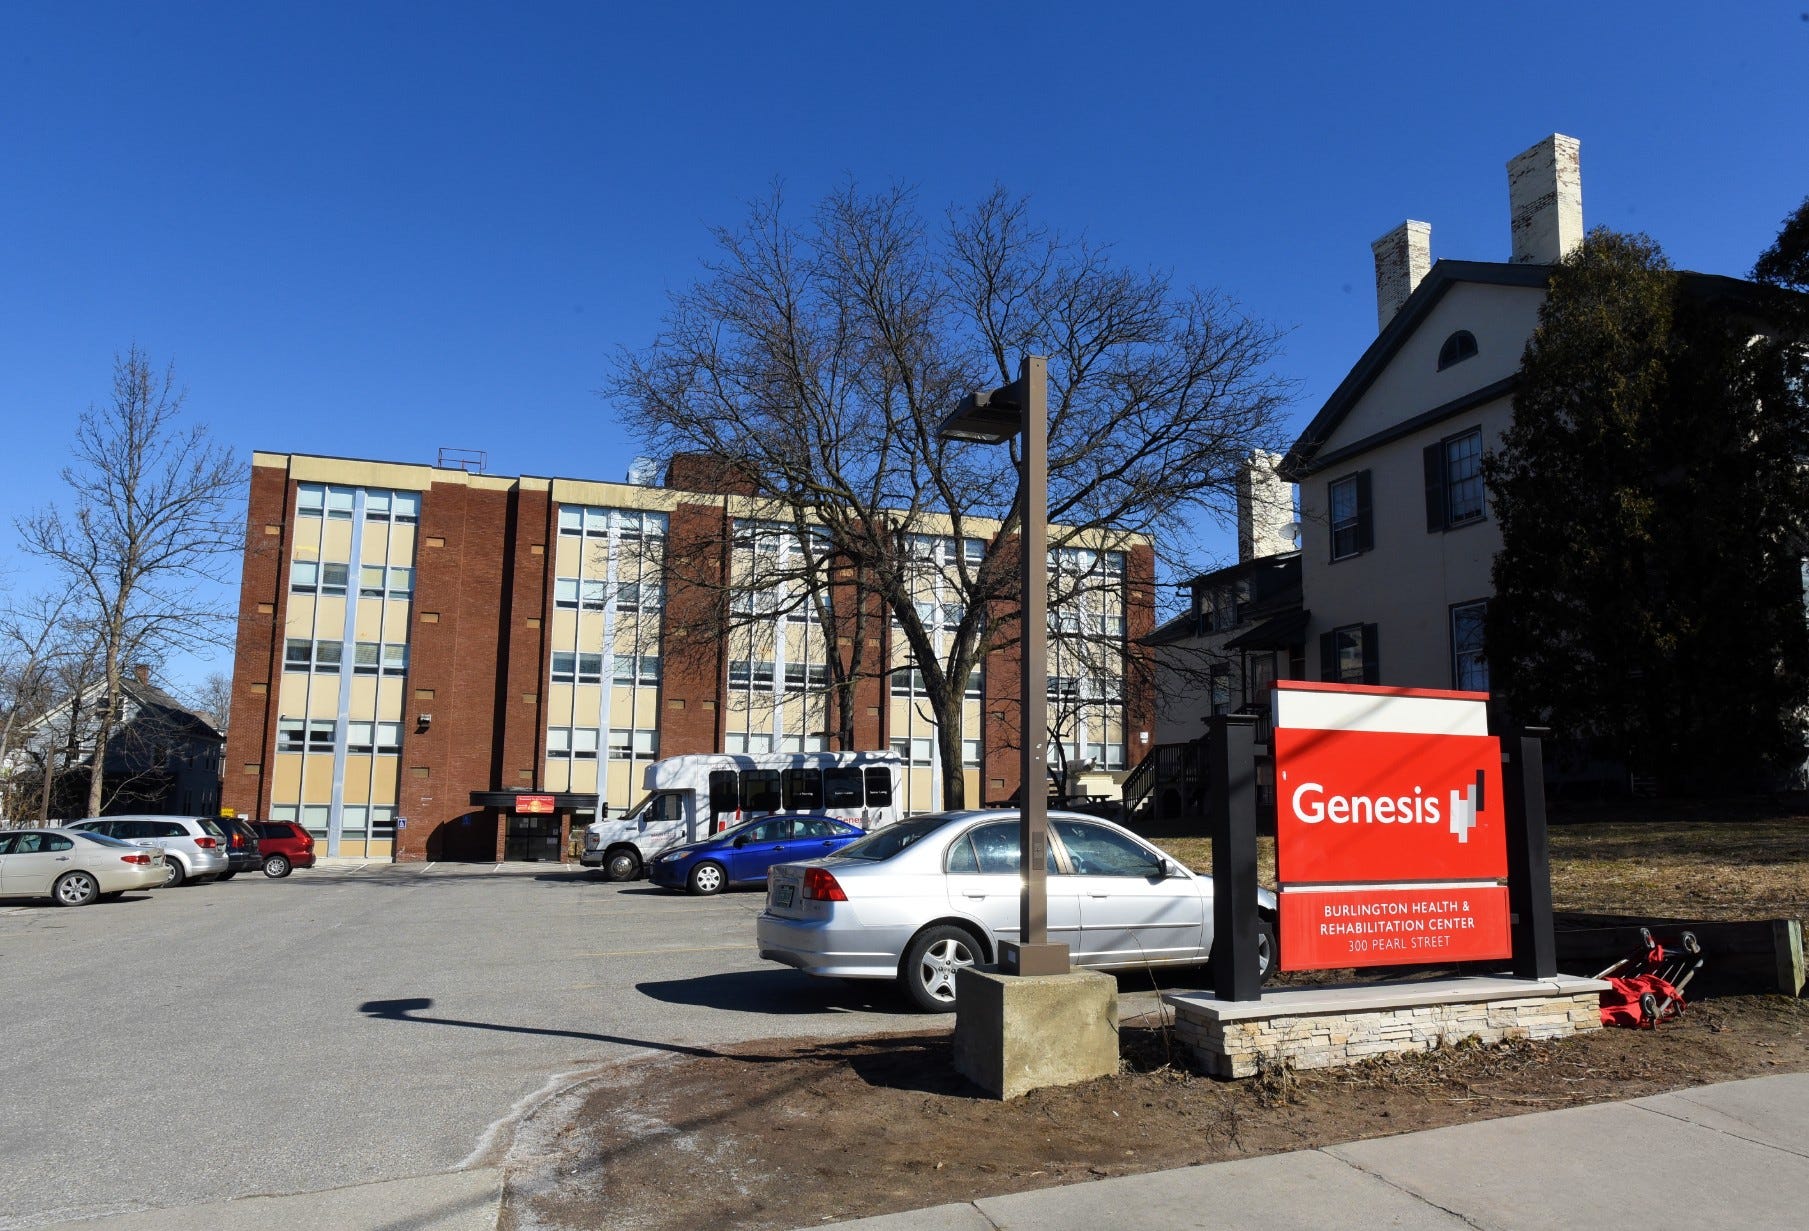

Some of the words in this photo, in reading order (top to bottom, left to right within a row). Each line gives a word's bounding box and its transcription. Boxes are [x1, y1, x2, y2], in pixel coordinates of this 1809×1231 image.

[1292, 783, 1441, 824] Genesis
[1325, 903, 1407, 917] BURLINGTON
[1413, 901, 1458, 913] HEALTH
[1462, 900, 1470, 912] &
[1320, 920, 1424, 936] REHABILITATION
[1429, 917, 1475, 931] CENTER
[1348, 938, 1368, 952] 300
[1373, 937, 1407, 950] PEARL
[1411, 935, 1451, 949] STREET
